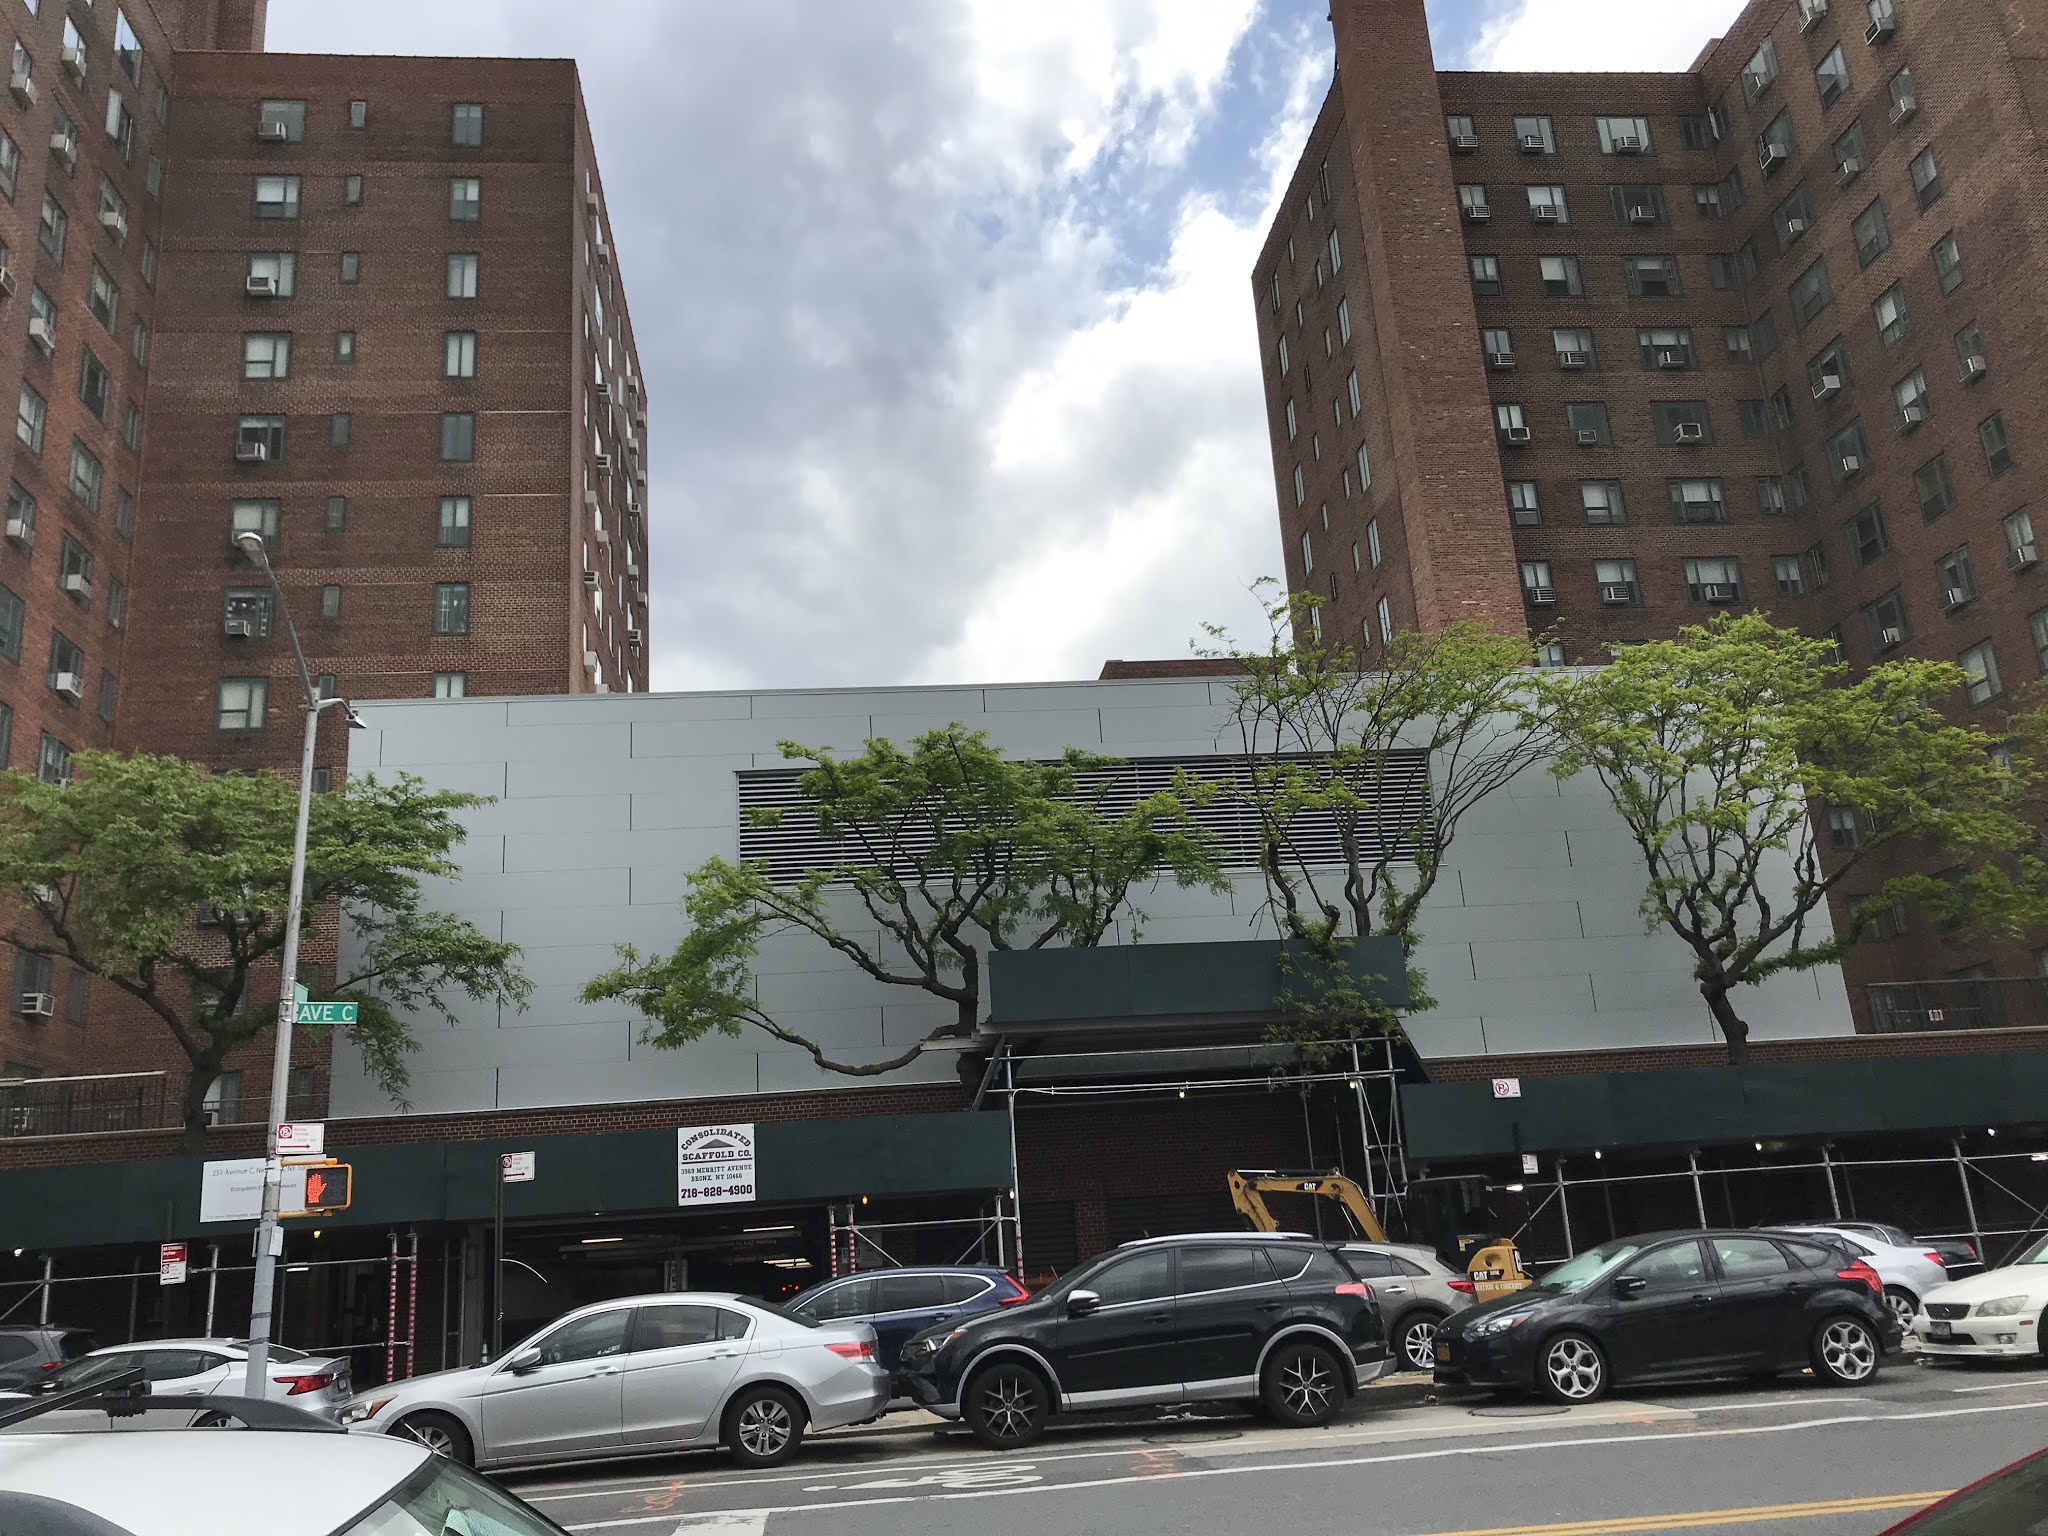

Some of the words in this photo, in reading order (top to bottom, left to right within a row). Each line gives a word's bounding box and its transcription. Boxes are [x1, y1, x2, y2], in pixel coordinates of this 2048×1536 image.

[298, 1005, 334, 1021] AVE
[342, 1005, 353, 1021] C
[681, 1128, 751, 1150] CONSOLIDATED
[682, 1150, 734, 1160] SCAFFOLD
[738, 1149, 751, 1157] CO.
[225, 1167, 248, 1176] Avenue
[696, 1166, 726, 1174] MERRITT
[715, 1173, 725, 1181] NY
[681, 1184, 752, 1198] 718-828-4900
[1304, 1182, 1316, 1191] CAT
[1473, 1271, 1488, 1281] CAT
